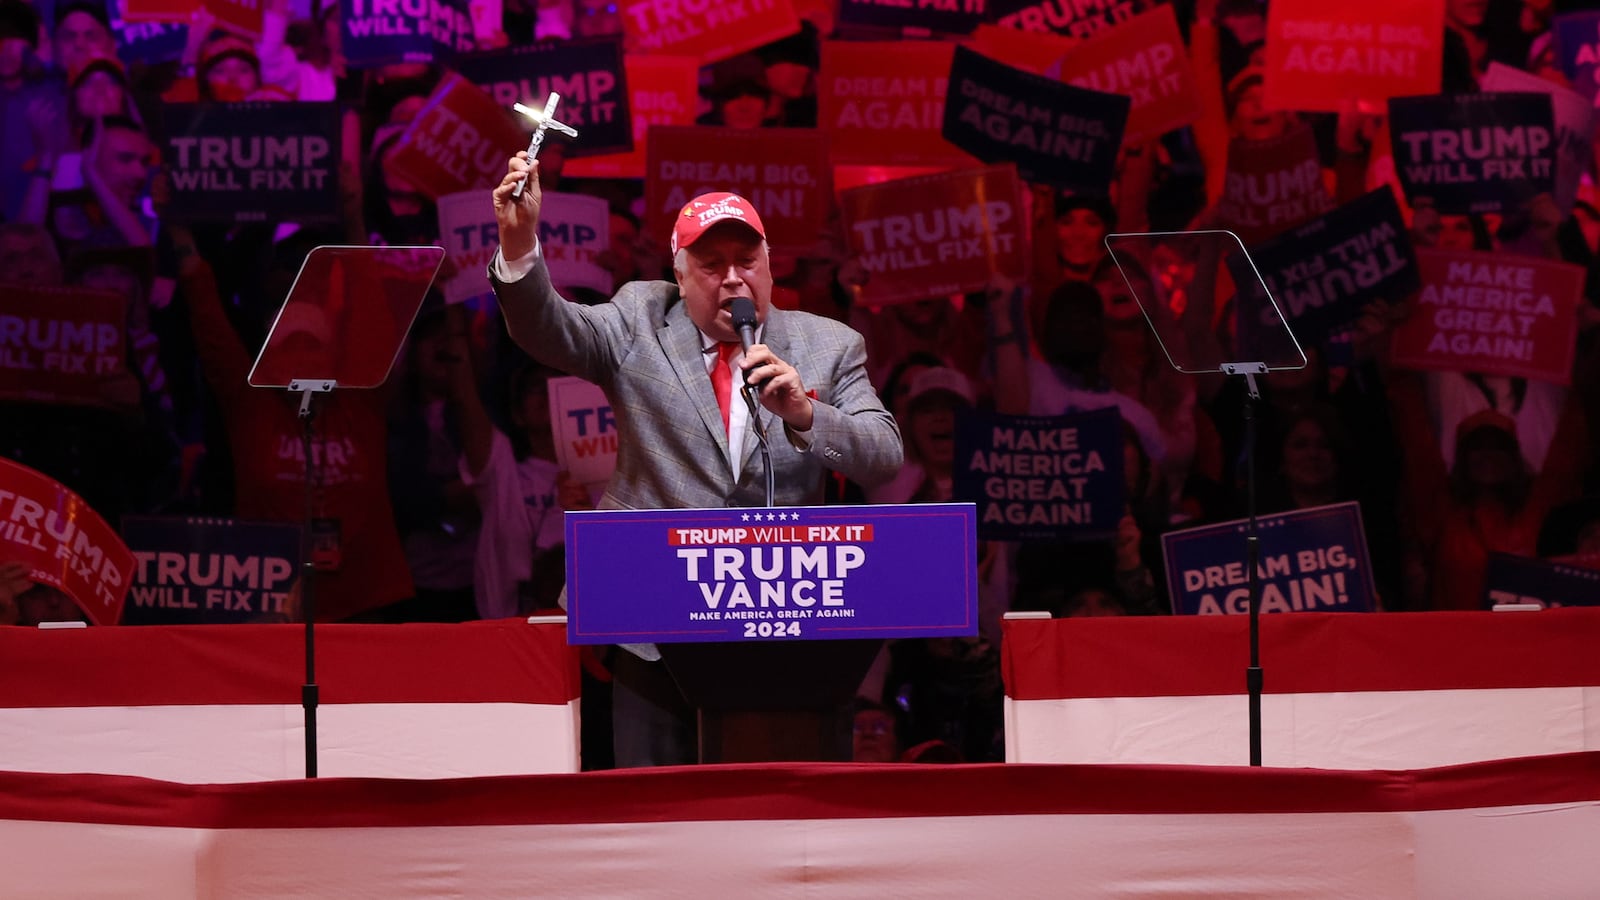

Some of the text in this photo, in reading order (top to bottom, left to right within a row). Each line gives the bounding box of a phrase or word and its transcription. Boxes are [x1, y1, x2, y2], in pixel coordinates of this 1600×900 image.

[347, 17, 411, 37] WILL
[1281, 19, 1373, 42] DREAM
[1282, 44, 1418, 78] AGAIN!
[833, 76, 927, 96] DREAM
[592, 102, 617, 124] IT
[634, 91, 685, 113] BIG,
[959, 78, 1052, 126] DREAM
[959, 102, 1097, 164] AGAIN!
[1401, 126, 1550, 162] TRUMP
[170, 136, 330, 169] TRUMP
[170, 169, 329, 191] WILL FIX IT
[659, 160, 817, 189] DREAM BIG,
[1404, 163, 1477, 184] WILL
[1481, 160, 1527, 180] FIX
[663, 185, 806, 219] AIN!
[698, 205, 745, 222] TRUMP
[453, 221, 597, 251] TRMP
[853, 201, 1013, 252] TRUMP
[858, 232, 1016, 273] WILL FIX IT
[1327, 221, 1396, 263] WILL
[1258, 243, 1408, 328] TRUMP
[1279, 254, 1326, 288] FIX
[1447, 261, 1536, 289] MAKE
[1418, 283, 1556, 319] AMERICA
[0, 315, 118, 352] RUMP
[1433, 308, 1537, 337] GREAT
[1427, 331, 1535, 362] AGAIN!
[42, 352, 88, 375] FIX
[992, 426, 1079, 452] MAKE
[968, 450, 1106, 475] AMERICA
[983, 476, 1089, 501] GREAT
[983, 501, 1092, 526] AGAIN!
[676, 525, 865, 545] TRUMP WILL FIX IT
[54, 542, 93, 586] FIX
[95, 580, 116, 608] IT
[135, 551, 293, 591] TRUMP
[677, 544, 867, 582] TRUMP
[1184, 545, 1357, 593] DREAM BIG,
[131, 586, 289, 613] WILL FIX IT
[698, 579, 845, 609] VANCE
[1196, 571, 1349, 616] AGAIN!
[689, 608, 855, 621] MAKE AMERICA GREAT AGAIN!
[743, 620, 802, 638] 2024
